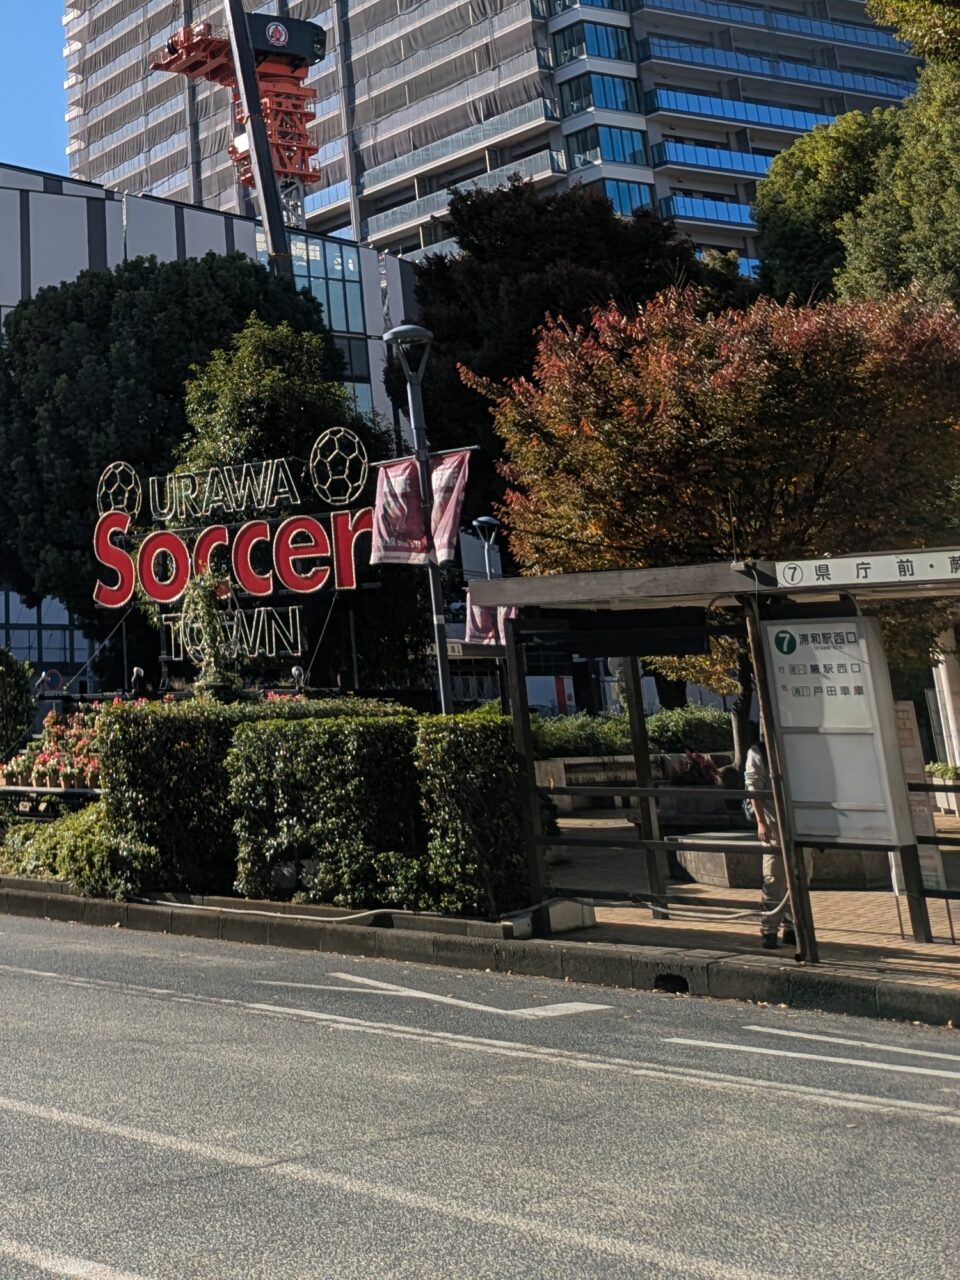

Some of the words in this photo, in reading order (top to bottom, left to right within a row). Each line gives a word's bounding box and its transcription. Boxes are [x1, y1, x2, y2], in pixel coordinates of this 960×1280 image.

[149, 458, 301, 520] URAWA
[93, 507, 376, 609] Soccer
[162, 606, 302, 662] TOWN
[798, 632, 857, 645] 浦和駅西口
